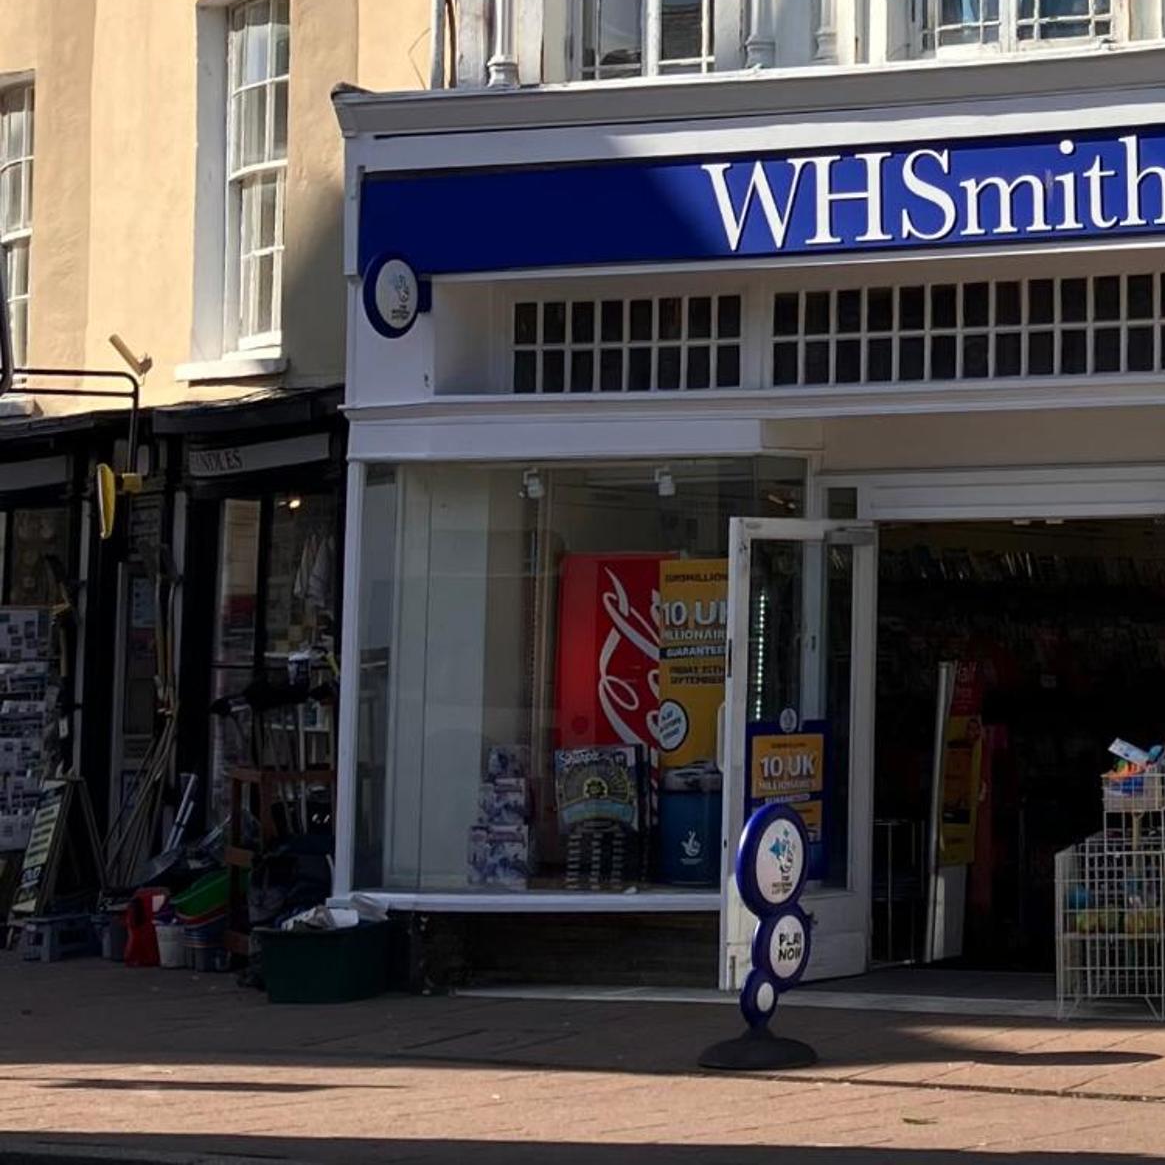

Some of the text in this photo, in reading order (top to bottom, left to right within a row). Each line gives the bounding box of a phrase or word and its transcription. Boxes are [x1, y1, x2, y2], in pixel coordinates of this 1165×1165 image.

[661, 602, 688, 626] 10
[760, 753, 816, 778] 10 UK
